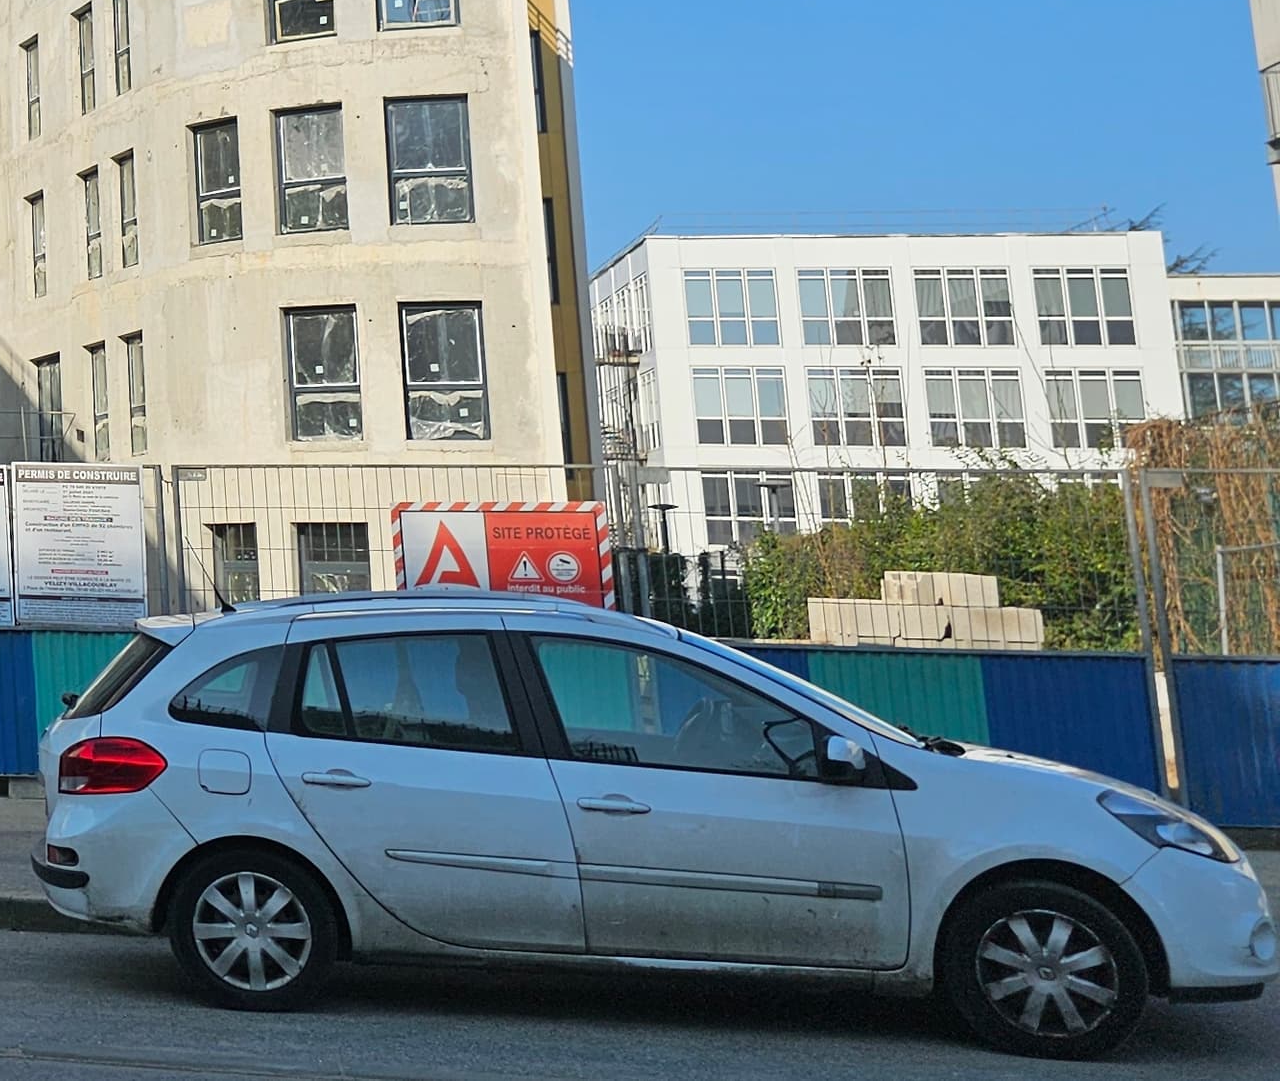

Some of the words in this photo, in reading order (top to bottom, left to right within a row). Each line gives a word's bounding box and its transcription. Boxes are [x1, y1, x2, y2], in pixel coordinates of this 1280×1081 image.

[18, 469, 55, 479] PERMIS
[57, 470, 71, 479] DE
[73, 471, 137, 481] CONSTRUIRE
[493, 527, 521, 539] SITE
[507, 583, 538, 593] interdit
[556, 585, 586, 594] public
